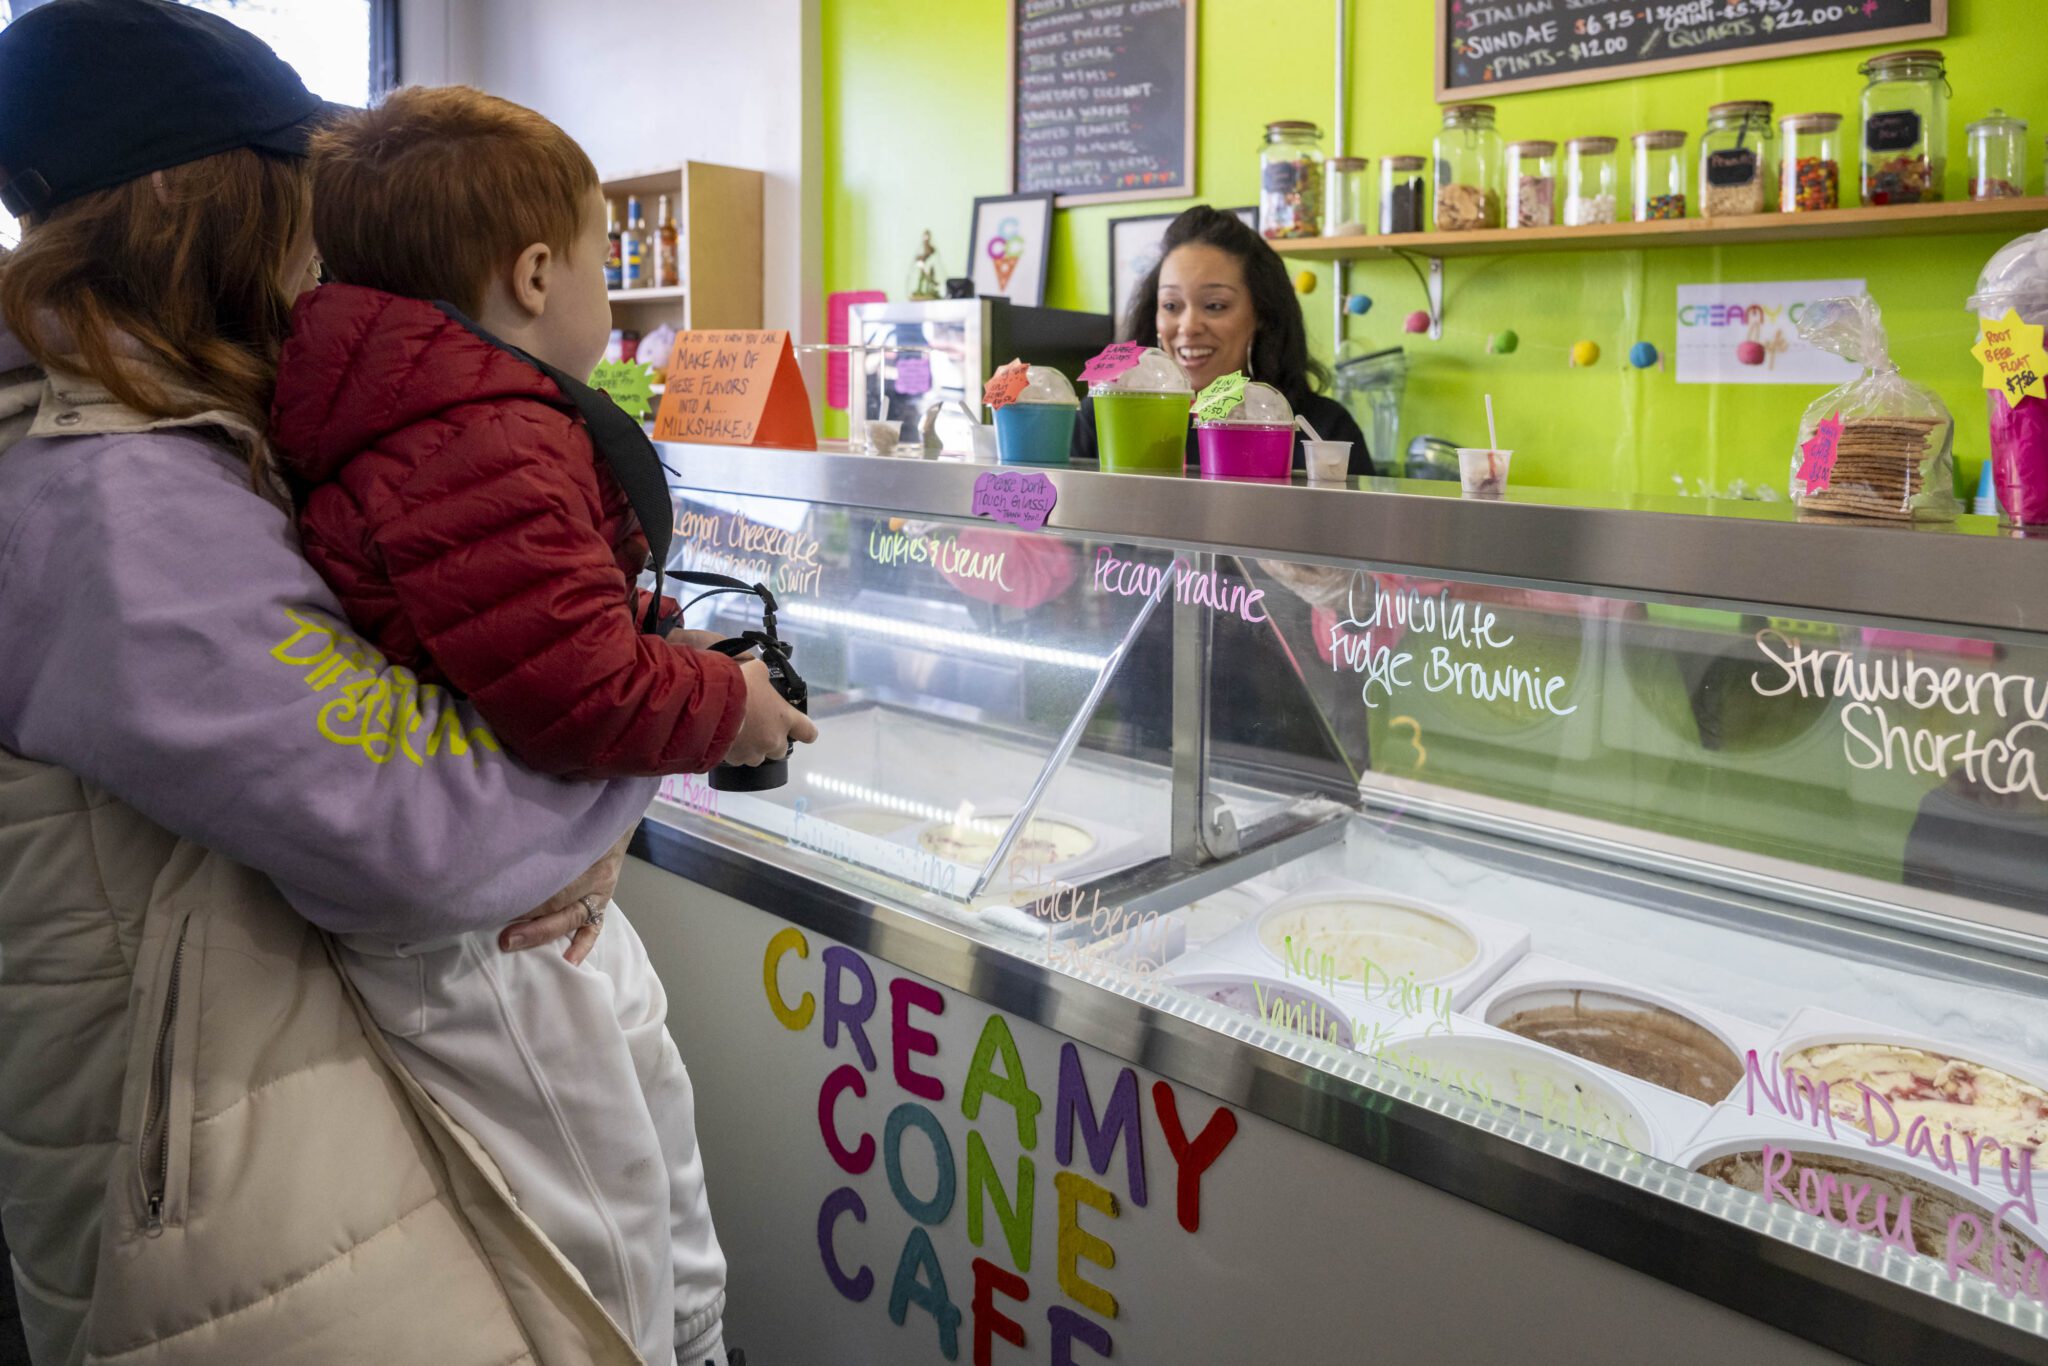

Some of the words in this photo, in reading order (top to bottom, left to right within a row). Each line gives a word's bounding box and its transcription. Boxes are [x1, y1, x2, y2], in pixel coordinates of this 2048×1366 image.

[1467, 1, 1553, 31] ITALIAN
[1667, 19, 1755, 48] QUARTS
[1760, 6, 1843, 34] $22.00
[1467, 21, 1557, 59] SUNDAE
[1679, 304, 1783, 327] CREAMY
[1984, 347, 2015, 362] BEER
[1985, 329, 2011, 346] ROOT
[676, 348, 713, 370] MAKE
[712, 349, 738, 371] ANY
[743, 350, 760, 369] OF
[1999, 354, 2030, 373] FLOAT
[668, 375, 696, 394] THESE
[699, 375, 750, 395] FLAVORS
[679, 399, 699, 414] INTO
[976, 489, 1007, 509] Touch
[984, 475, 1017, 493] Please
[672, 508, 721, 546] Lemon
[728, 510, 820, 567] Cheesecake
[869, 522, 929, 567] Cookies
[942, 536, 1014, 592] Cream
[776, 563, 822, 598] Swirl
[1094, 547, 1163, 601] Pecan
[1174, 557, 1267, 622] Praline
[1348, 569, 1515, 649] Chocolate
[1329, 619, 1413, 708] Fudge
[1423, 646, 1578, 716] Brownie
[1009, 855, 1174, 970] Blackberry
[1253, 980, 1338, 1046] Vanilla
[764, 927, 1238, 1233] CREAMY
[818, 1064, 1121, 1320] CONE
[1762, 1144, 1918, 1262] Rocky
